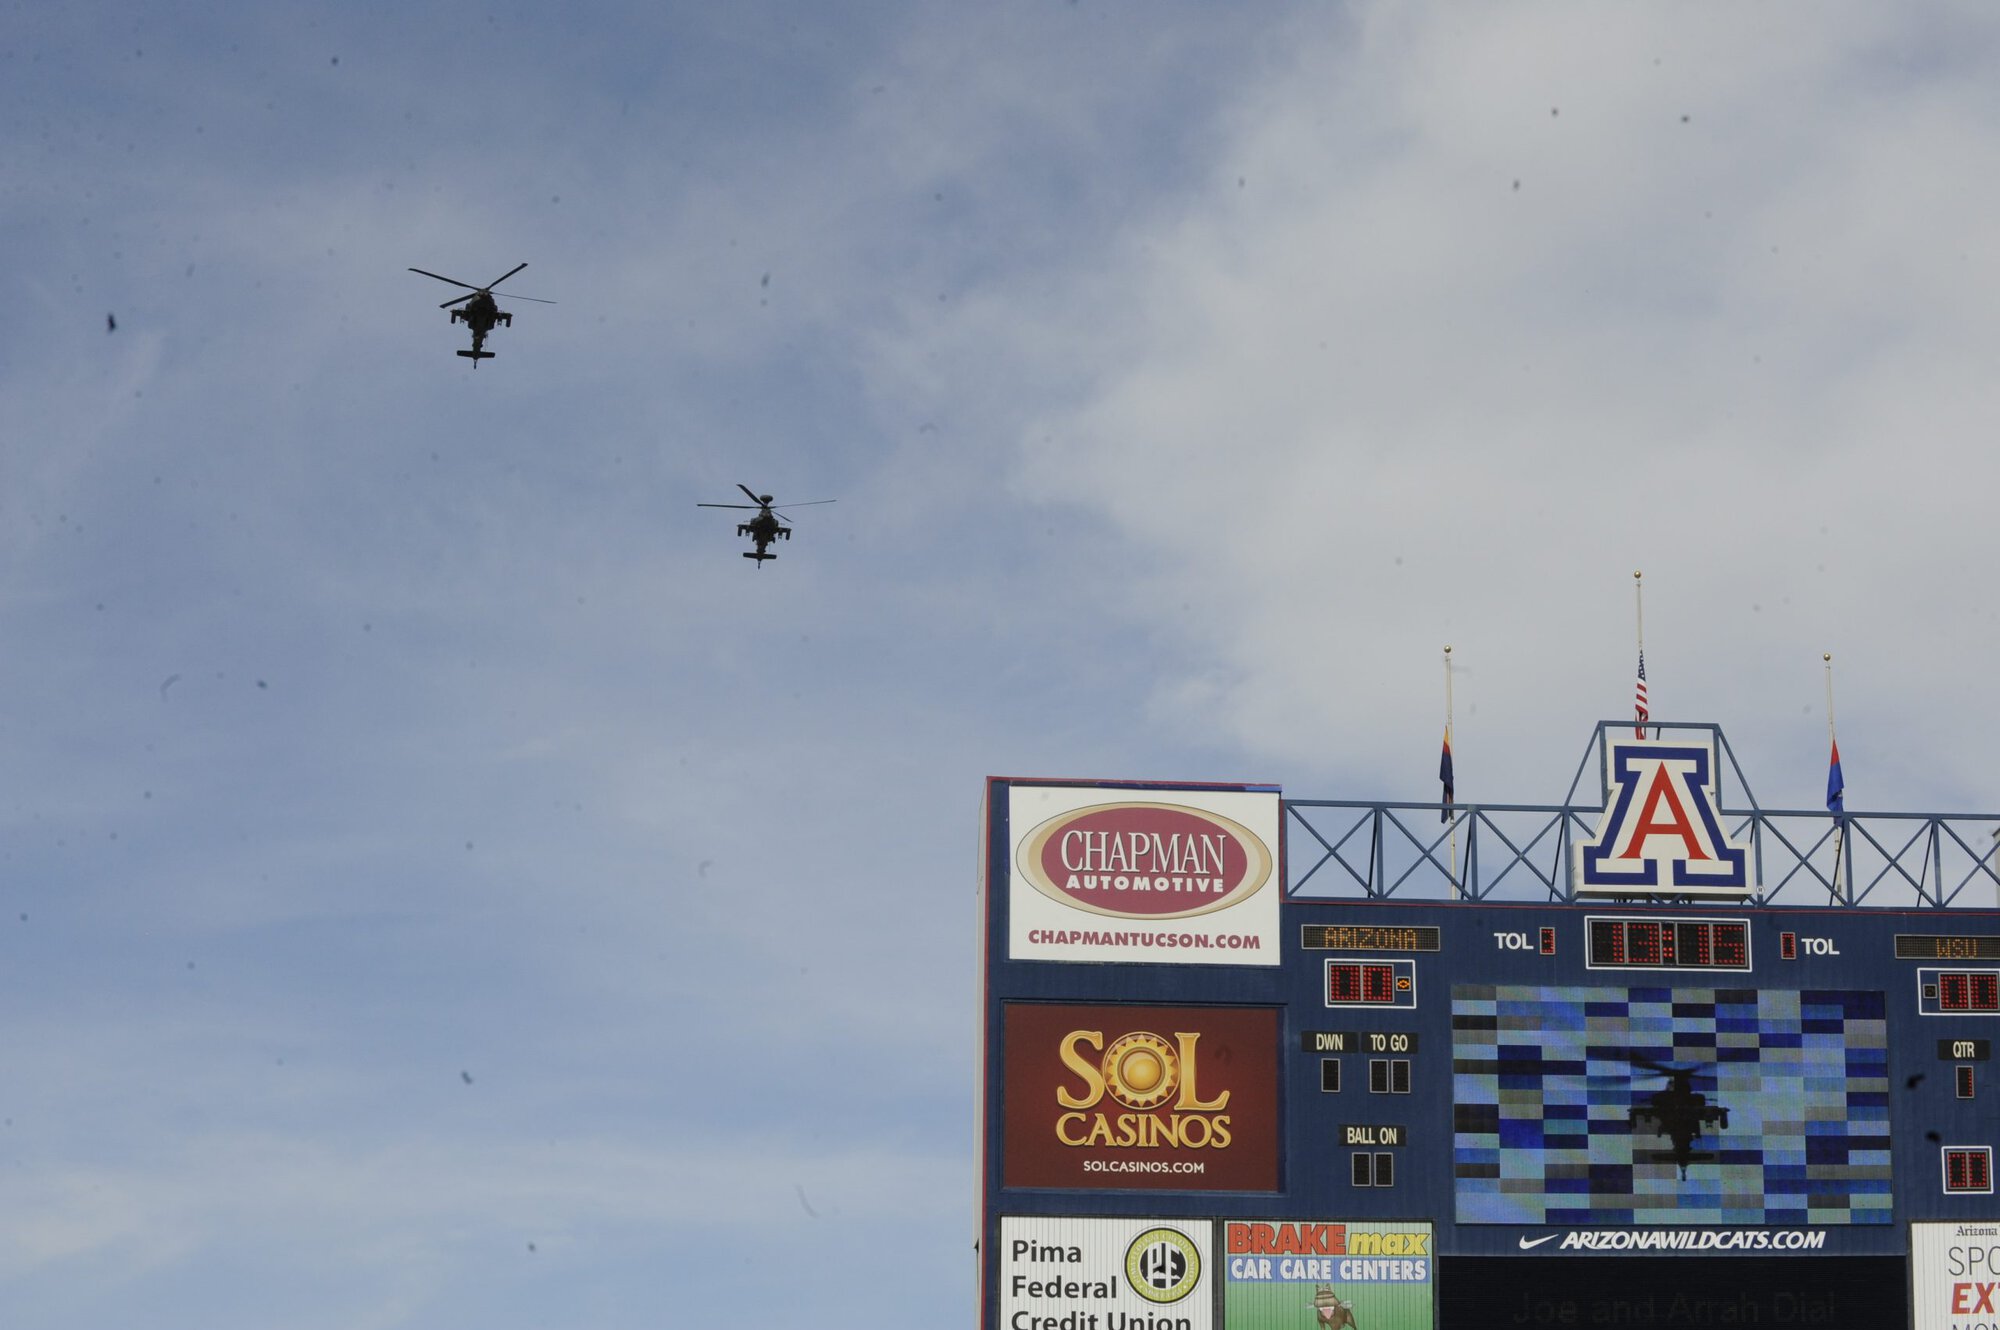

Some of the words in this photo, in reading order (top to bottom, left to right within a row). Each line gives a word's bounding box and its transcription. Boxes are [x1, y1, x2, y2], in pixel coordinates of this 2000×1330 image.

[1583, 745, 1746, 887] A
[1061, 830, 1226, 875] CHAPMAN
[1066, 874, 1224, 892] AUTOMOTIVE
[1028, 930, 1260, 949] CHAPMANTUCSON.COM
[1324, 927, 1417, 949] ARIZONA
[1494, 933, 1534, 950] TOL
[1801, 938, 1840, 955] TOL
[1936, 938, 1977, 958] WSU
[1316, 1033, 1343, 1050] DWN
[1370, 1034, 1386, 1051] TO
[1390, 1034, 1408, 1051] GO
[1953, 1041, 1975, 1058] QTR
[1056, 1030, 1230, 1111] SOL
[1056, 1112, 1232, 1148] CASINOS
[1347, 1127, 1376, 1144] BALL
[1380, 1127, 1397, 1145] ON
[1083, 1160, 1204, 1173] SOLCASINOS.COM
[1560, 1230, 1826, 1249] ARIZONAWILDCATS.COM
[1956, 1225, 1997, 1236] Arizona
[1012, 1239, 1082, 1263] Pima
[1231, 1258, 1272, 1279] CAR
[1280, 1258, 1332, 1280] CARE
[1339, 1259, 1427, 1281] CENTERS
[1012, 1275, 1117, 1298] Federal
[1513, 1292, 1579, 1325] Joe
[1591, 1293, 1655, 1324] and
[1774, 1290, 1837, 1322] Dial
[1952, 1282, 2000, 1314] EX
[1011, 1311, 1098, 1330] Credit
[1107, 1311, 1191, 1330] Union
